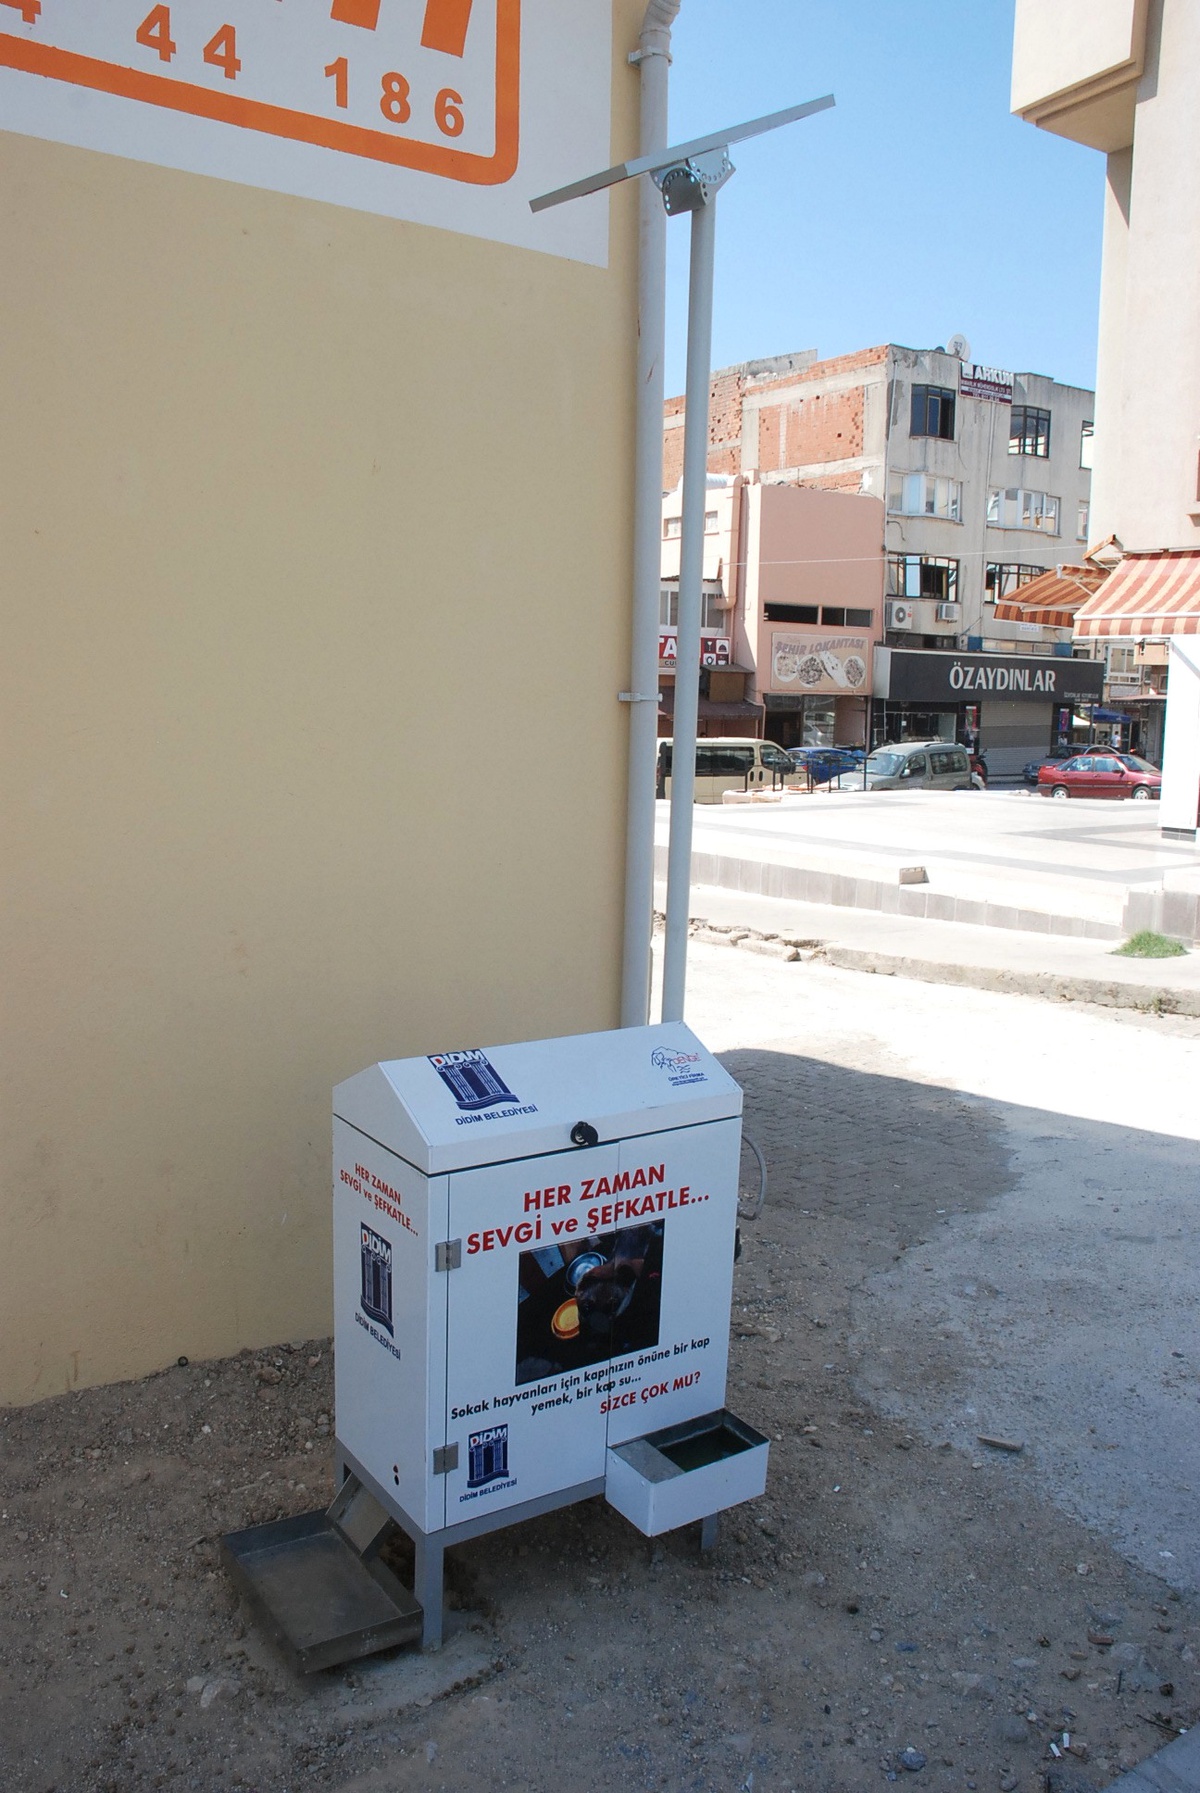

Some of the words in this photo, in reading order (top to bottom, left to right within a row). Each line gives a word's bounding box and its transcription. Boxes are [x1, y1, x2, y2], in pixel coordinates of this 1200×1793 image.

[809, 638, 864, 655] LOKANTASI
[949, 661, 1056, 692] ÖZAYDINLAR
[455, 1115, 483, 1125] DİDİM
[484, 1103, 538, 1121] BELEDİYESİ
[340, 1169, 362, 1194] SEVGİ
[363, 1189, 372, 1202] ve
[374, 1194, 419, 1237] ŞEFKATLE...
[355, 1163, 370, 1183] HER
[371, 1175, 401, 1205] ZAMAN
[523, 1184, 571, 1213] HER
[580, 1163, 665, 1201] ZAMAN
[467, 1214, 542, 1255] SEVGİ
[551, 1218, 578, 1236] ve
[587, 1186, 710, 1233] ŞEFKATLE...
[370, 1325, 401, 1361] BELEDİYESİ
[451, 1399, 490, 1420] Sokak
[493, 1382, 558, 1409] hayvanları
[560, 1375, 581, 1391] için
[583, 1359, 634, 1383] kapınızın
[637, 1349, 671, 1367] önüne
[673, 1343, 689, 1355] bir
[690, 1337, 710, 1350] kap
[531, 1392, 573, 1416] yemek,
[576, 1387, 593, 1400] bir
[595, 1380, 616, 1394] kap
[618, 1376, 642, 1387] su...
[599, 1391, 637, 1415] SİZCE
[640, 1381, 669, 1404] ÇOK
[672, 1371, 701, 1391] MU?
[469, 1427, 507, 1448] DİDİM
[459, 1491, 478, 1503] DİDİM
[479, 1477, 518, 1497] BELEDİYESİ
